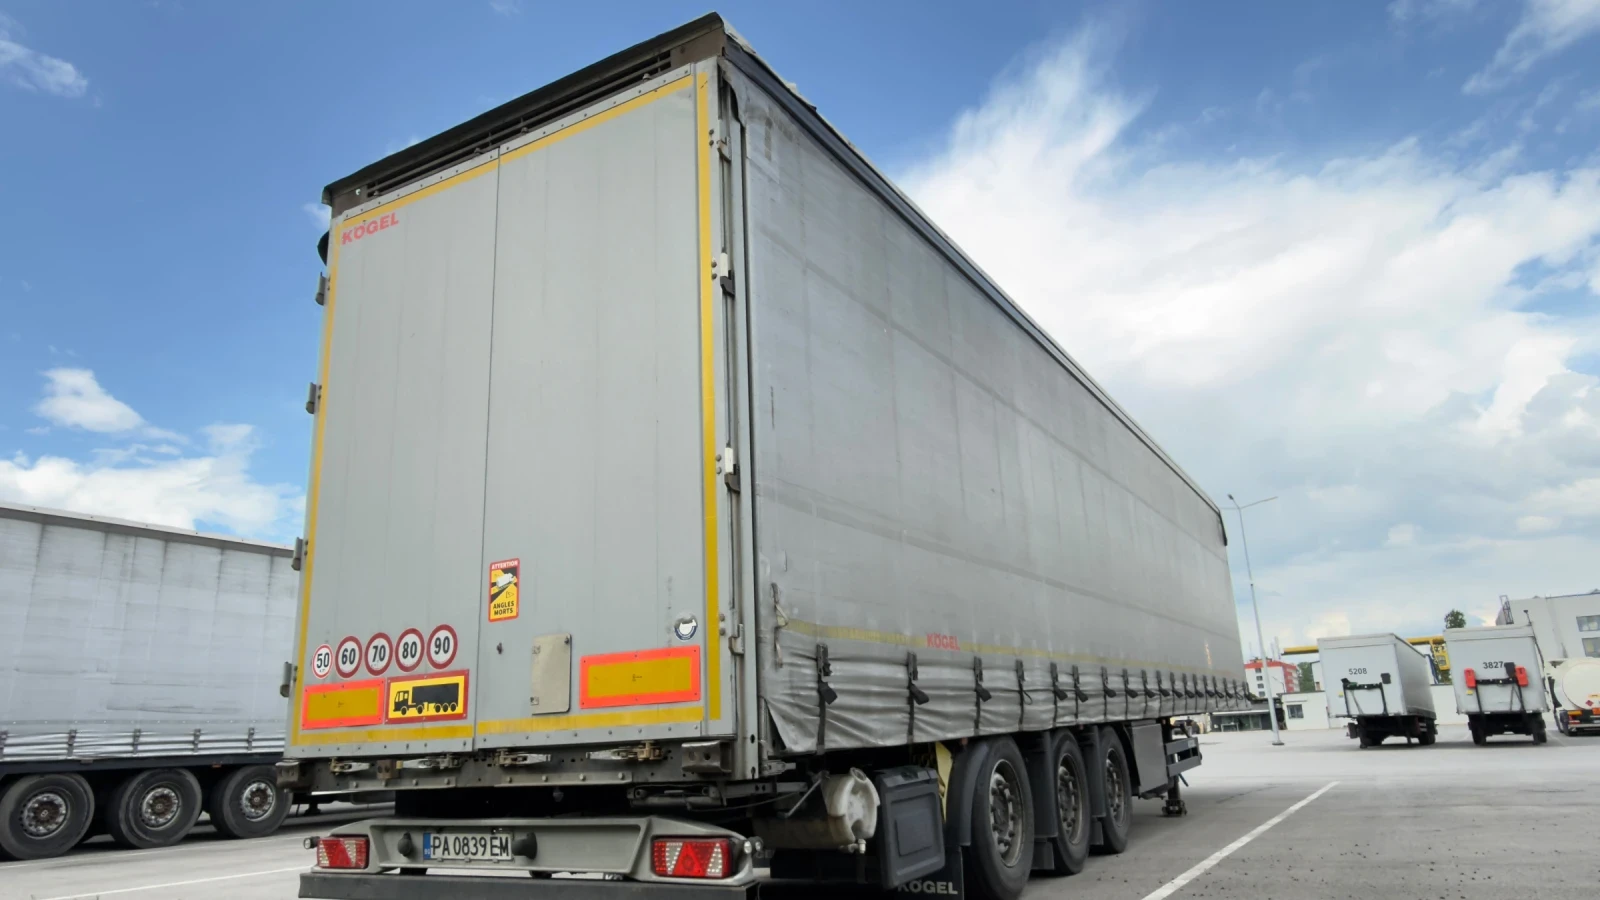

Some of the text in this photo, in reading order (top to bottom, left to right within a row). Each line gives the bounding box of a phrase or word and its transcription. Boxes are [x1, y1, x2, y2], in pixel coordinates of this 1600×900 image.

[491, 560, 518, 569] ATTENTION
[493, 600, 515, 609] ANGLES
[494, 607, 514, 616] MORTS
[402, 641, 418, 659] 80
[434, 636, 450, 655] 90
[926, 633, 960, 651] KÖGEL
[316, 652, 330, 669] 50
[341, 647, 356, 665] 60
[372, 644, 387, 663] 70
[1348, 667, 1368, 675] 5208
[1482, 661, 1504, 669] 3827
[432, 836, 510, 856] PA 0839 EM
